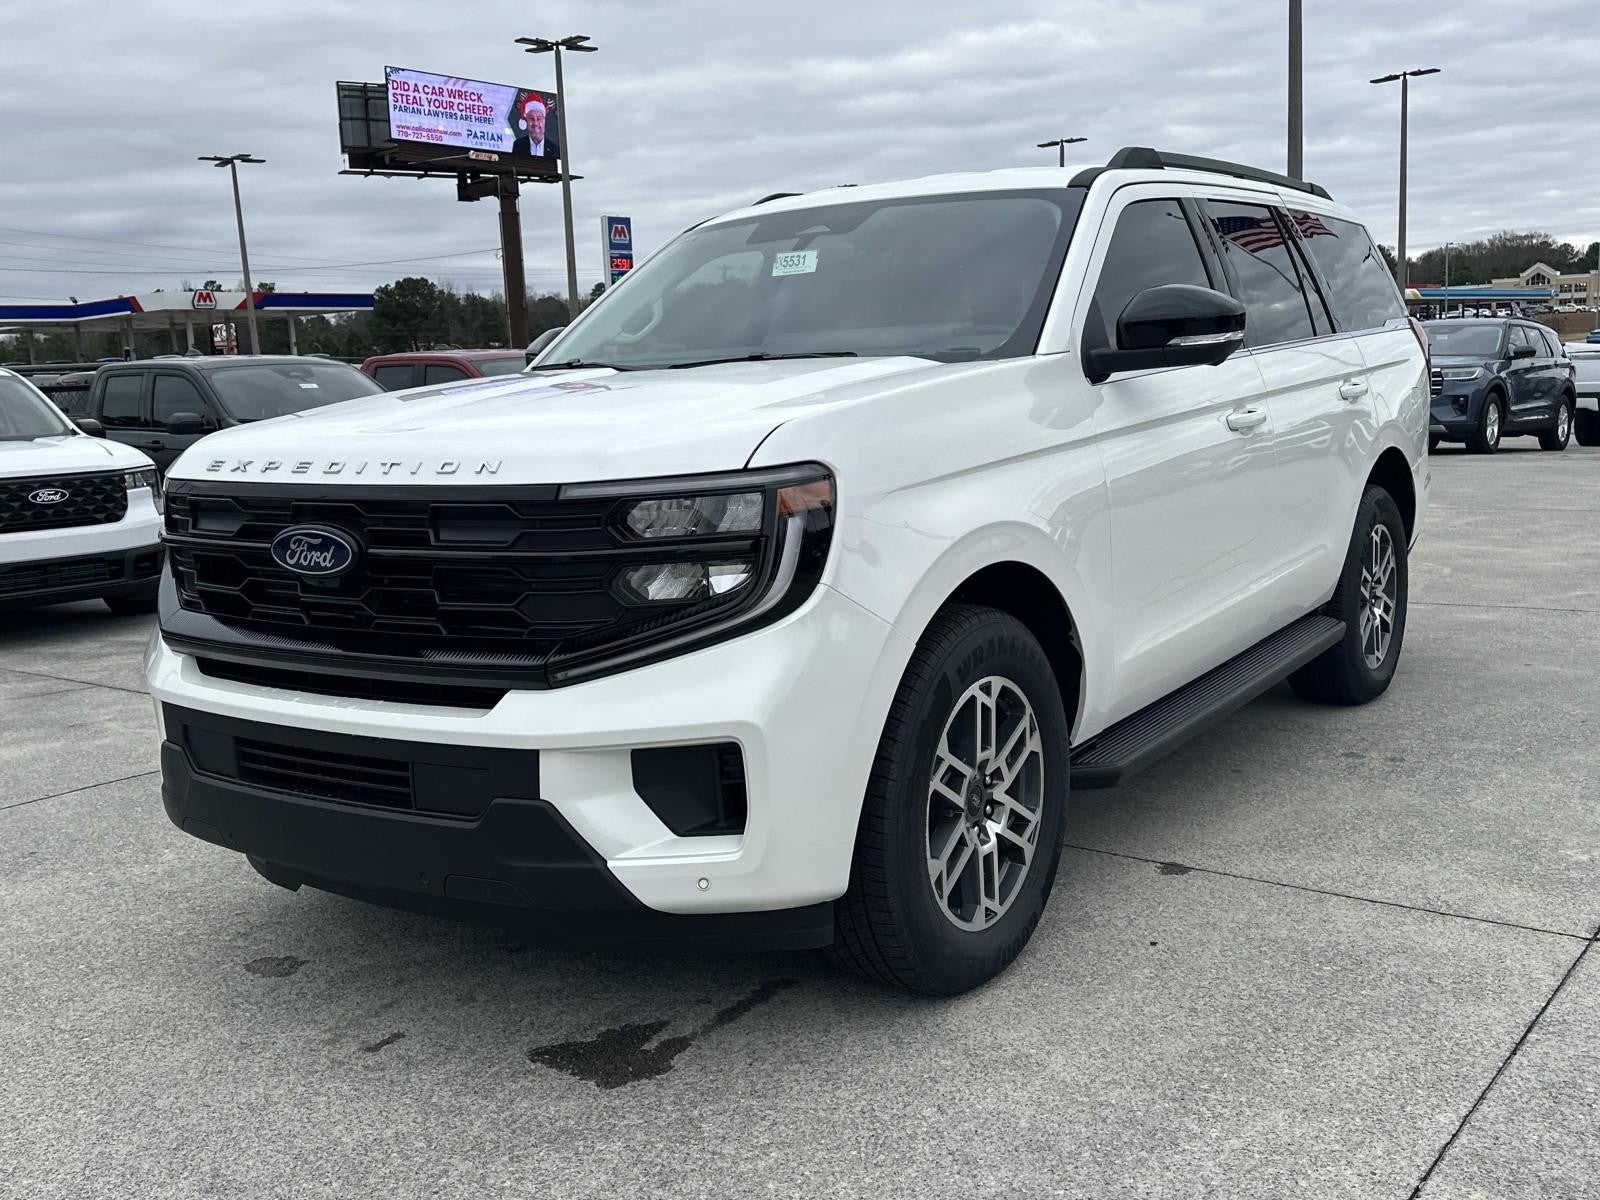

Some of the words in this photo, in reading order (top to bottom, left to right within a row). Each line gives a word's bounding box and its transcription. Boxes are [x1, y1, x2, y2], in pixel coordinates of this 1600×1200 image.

[391, 80, 410, 92] DID
[412, 84, 421, 94] A
[422, 84, 444, 97] CAR
[445, 88, 483, 103] WRECK
[392, 92, 424, 107] STEAL
[425, 97, 455, 112] YOUR
[456, 102, 493, 117] CHEER?
[393, 104, 422, 116] PARIAN
[423, 107, 458, 120] LAWYERS
[459, 114, 473, 123] ARE
[466, 129, 503, 143] PARIAN
[205, 459, 503, 475] EXPEDITION
[285, 534, 336, 568] Ford
